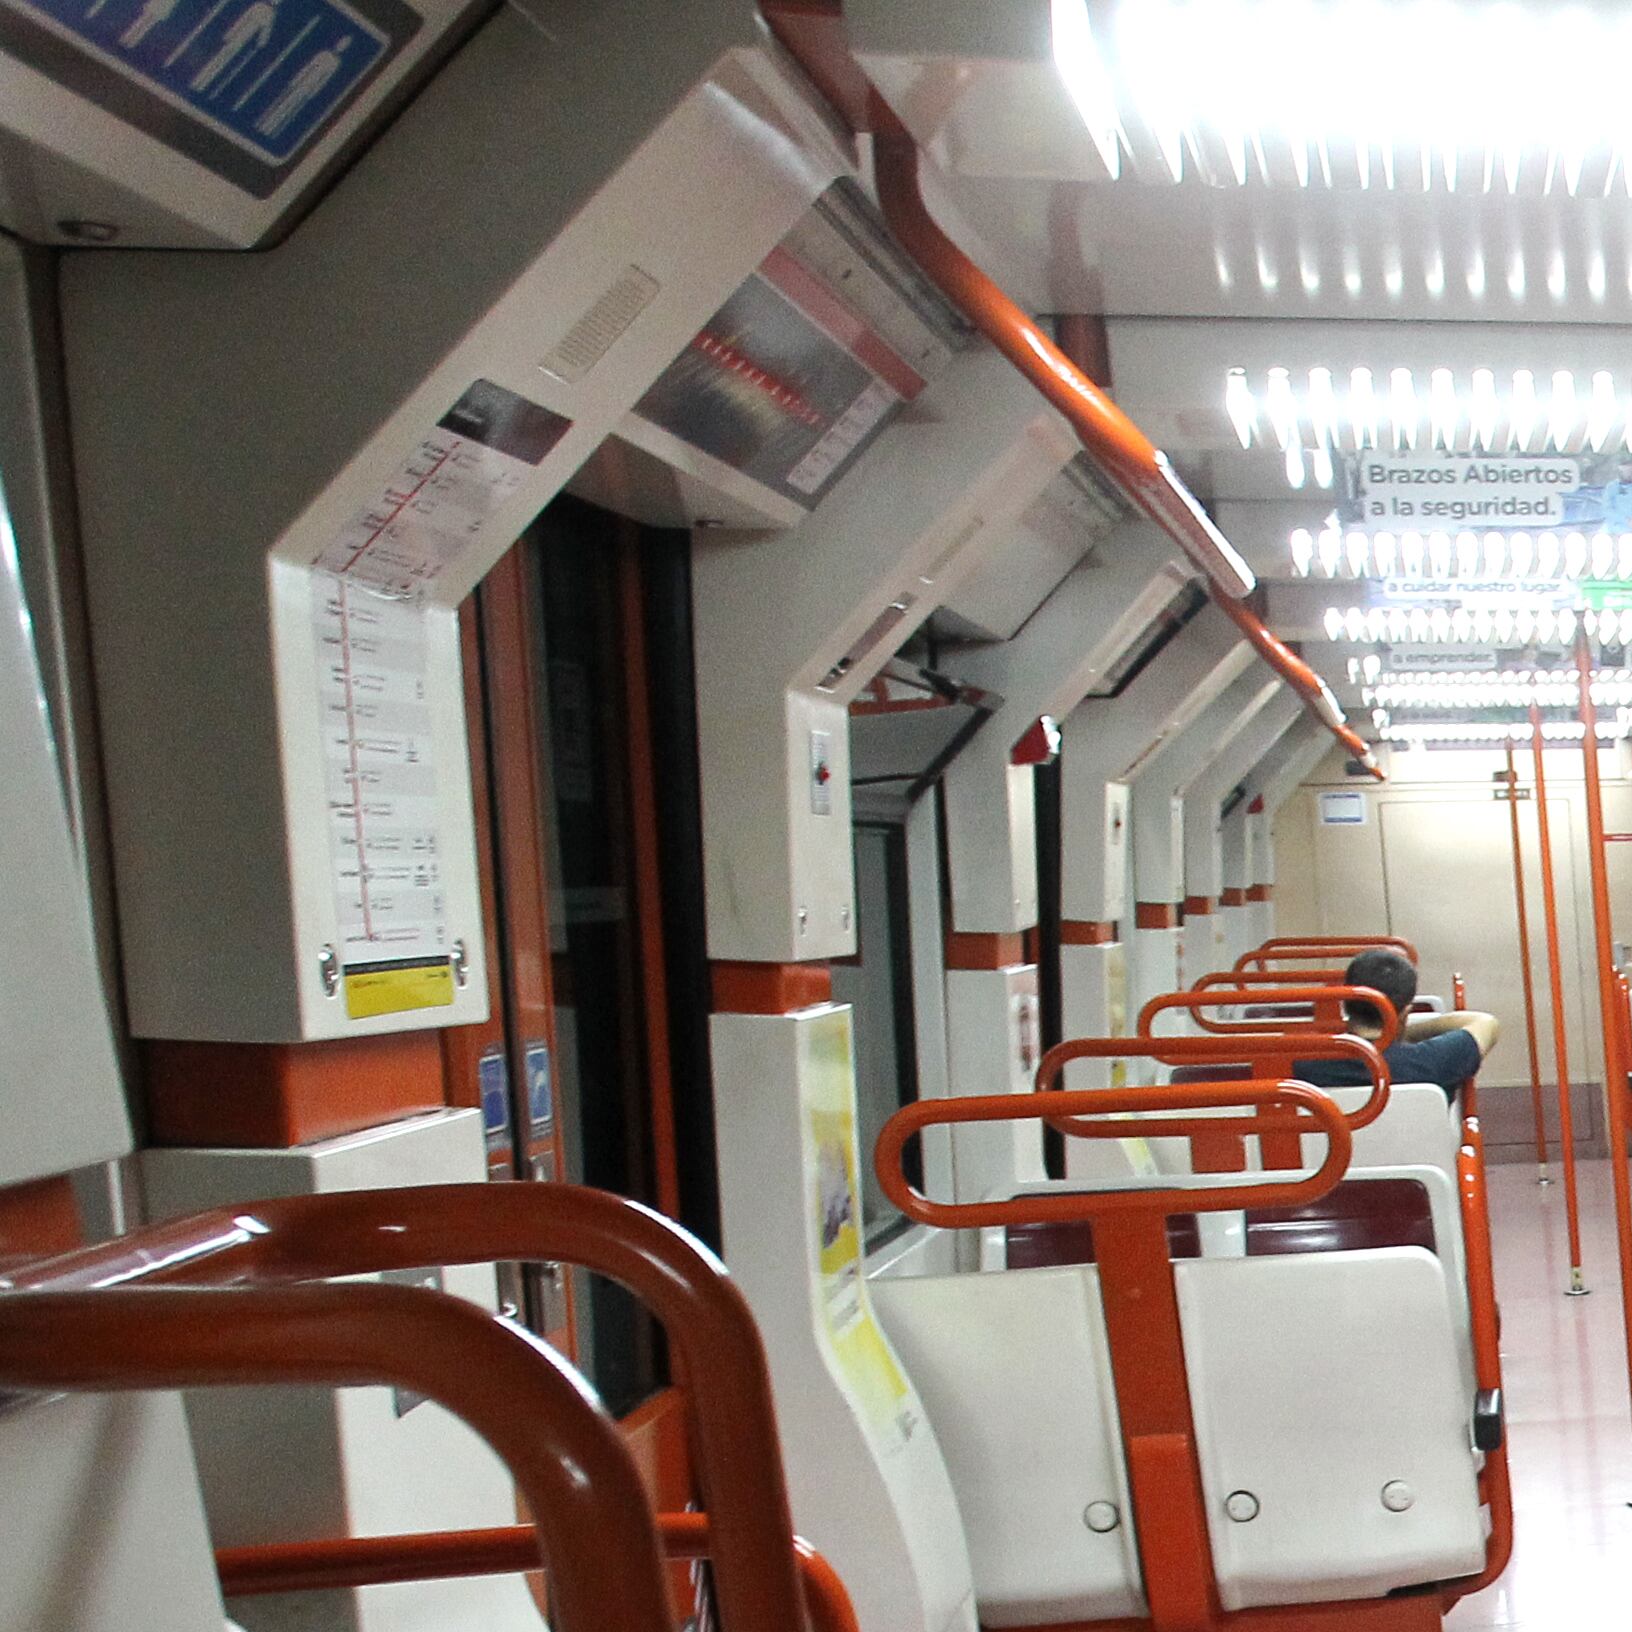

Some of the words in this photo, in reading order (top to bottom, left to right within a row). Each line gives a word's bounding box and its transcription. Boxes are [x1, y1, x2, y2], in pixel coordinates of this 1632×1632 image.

[1368, 464, 1457, 484] Brazos
[1464, 464, 1573, 484] Abiertos
[1371, 501, 1385, 516] a
[1392, 497, 1414, 516] la
[1421, 497, 1557, 520] seguridad.
[1456, 581, 1516, 592] nuestro
